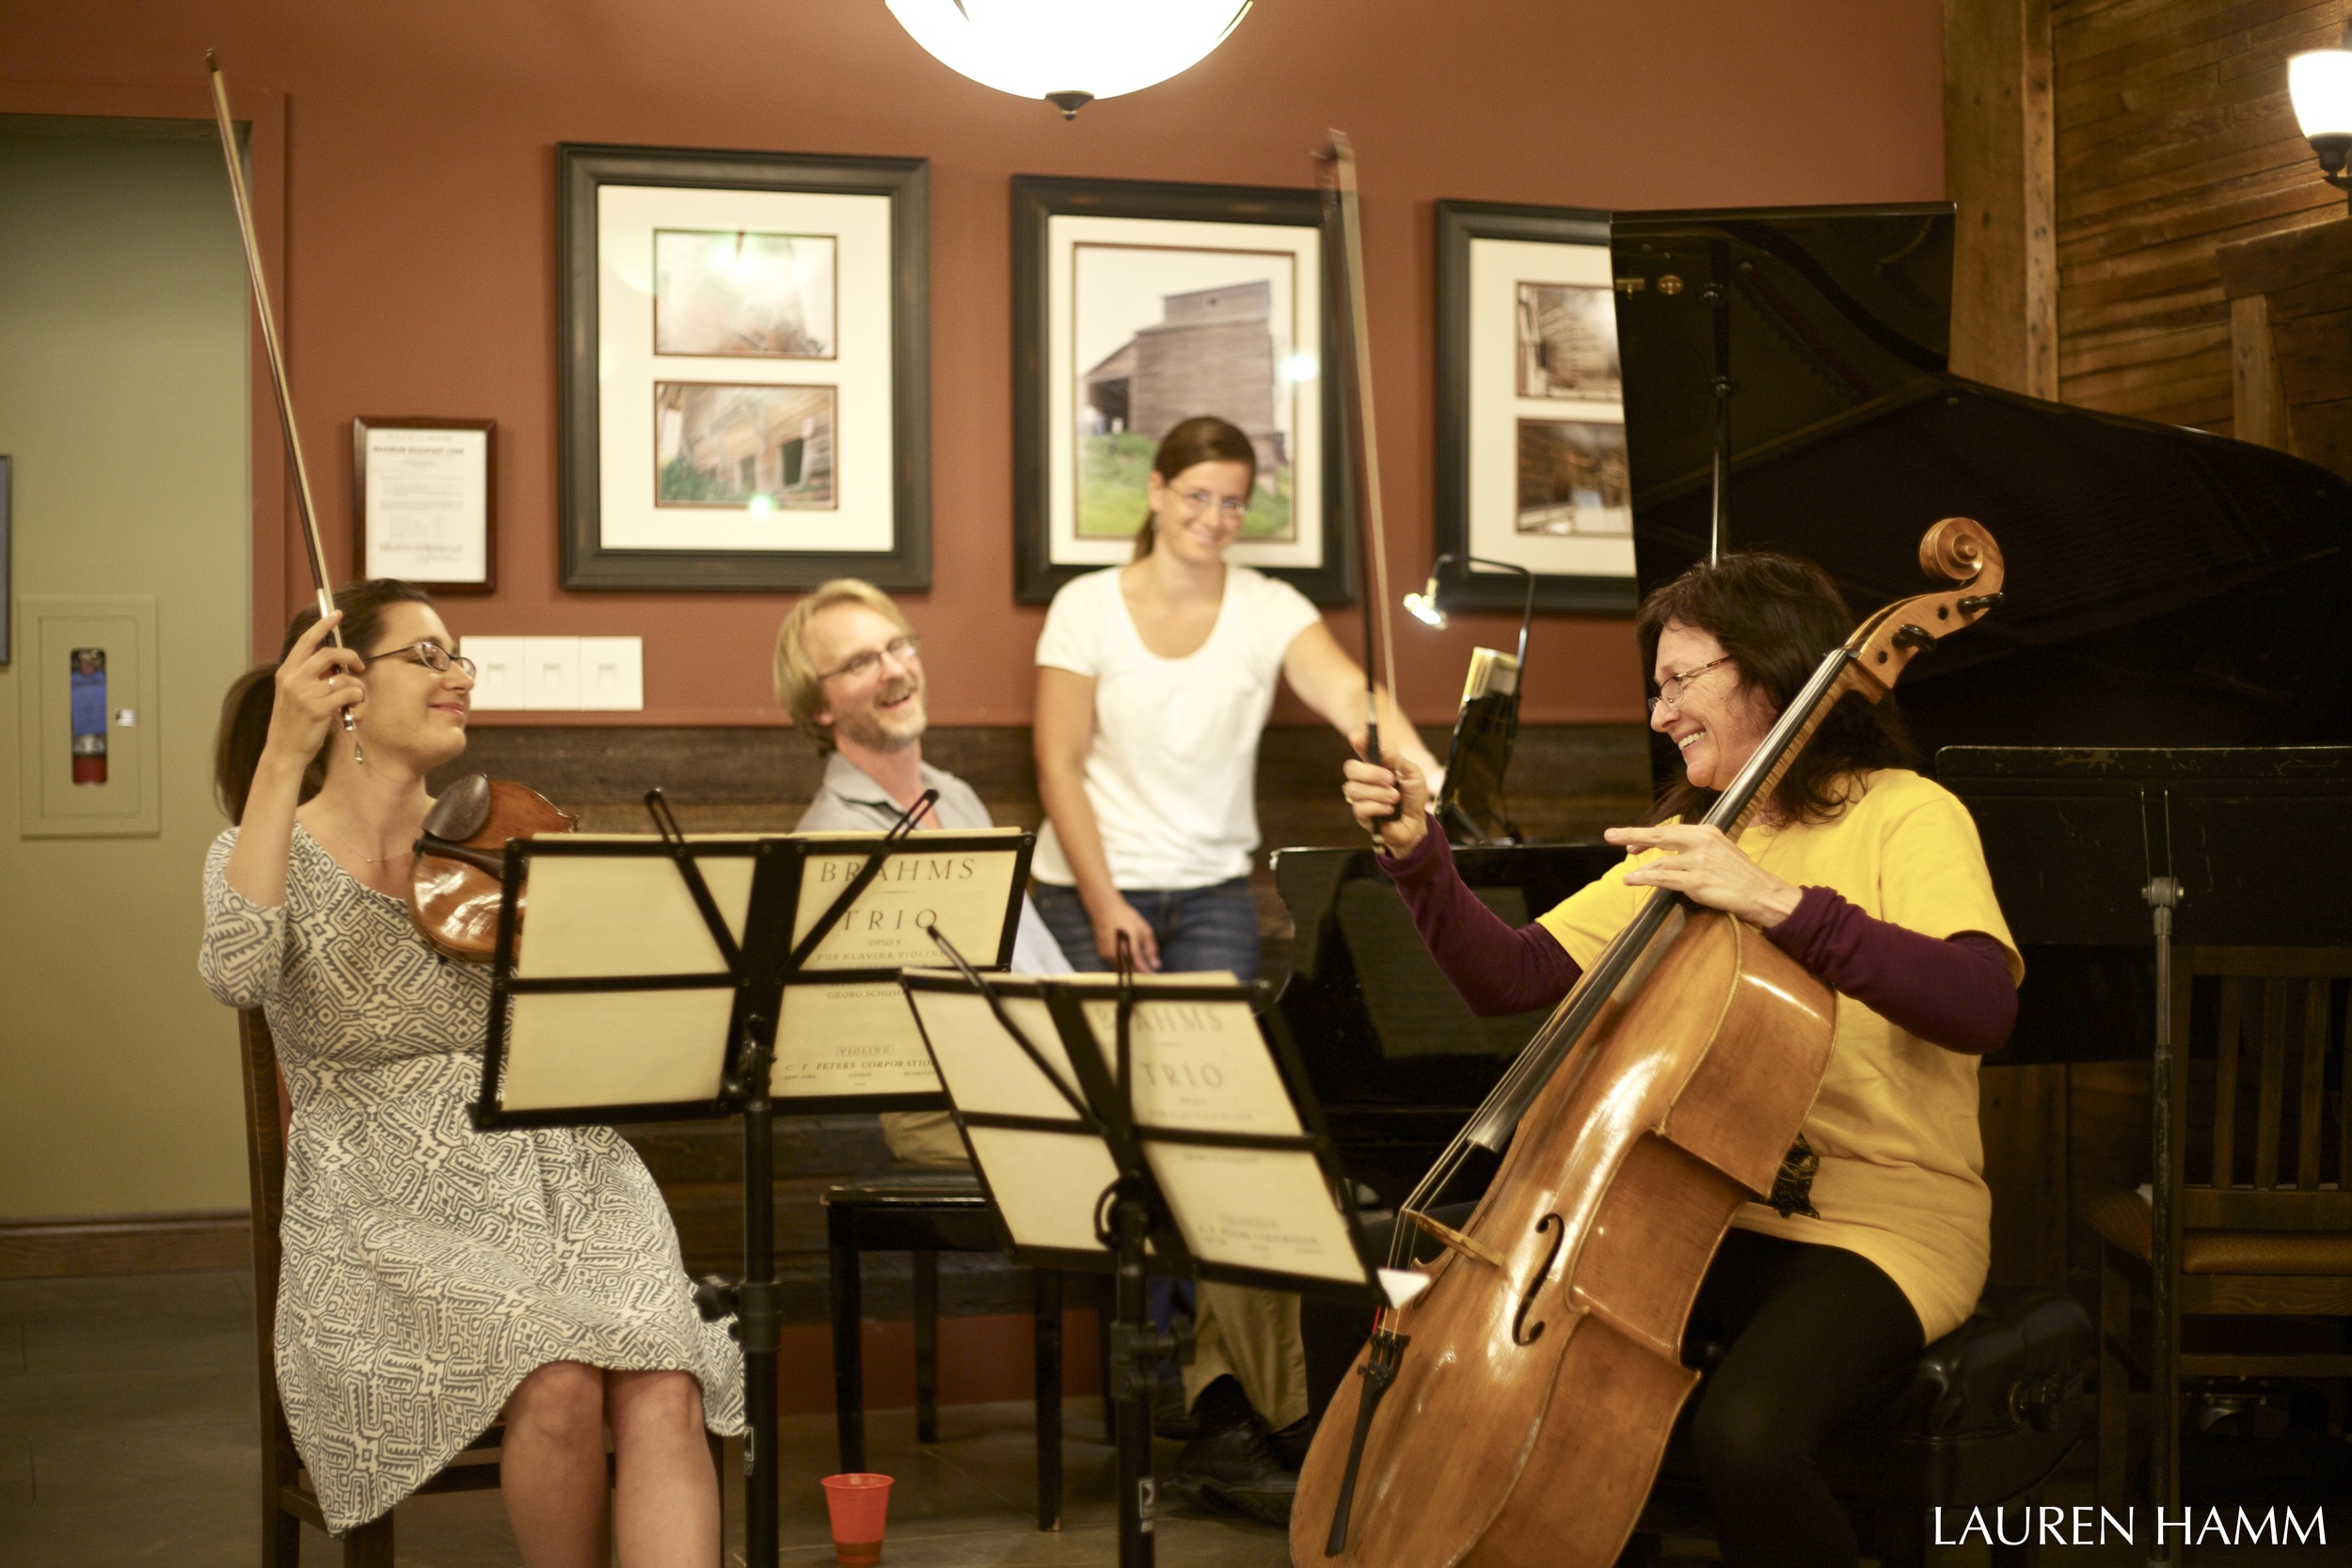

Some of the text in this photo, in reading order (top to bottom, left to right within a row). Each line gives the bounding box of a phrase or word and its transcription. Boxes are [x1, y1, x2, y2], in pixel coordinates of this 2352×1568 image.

[819, 858, 976, 883] BRAHMS
[844, 909, 938, 931] TRIO
[827, 990, 864, 999] GEORG
[839, 1046, 891, 1055] VIOLINE
[817, 1061, 856, 1070] PETERS
[1138, 1061, 1224, 1089] TRIO
